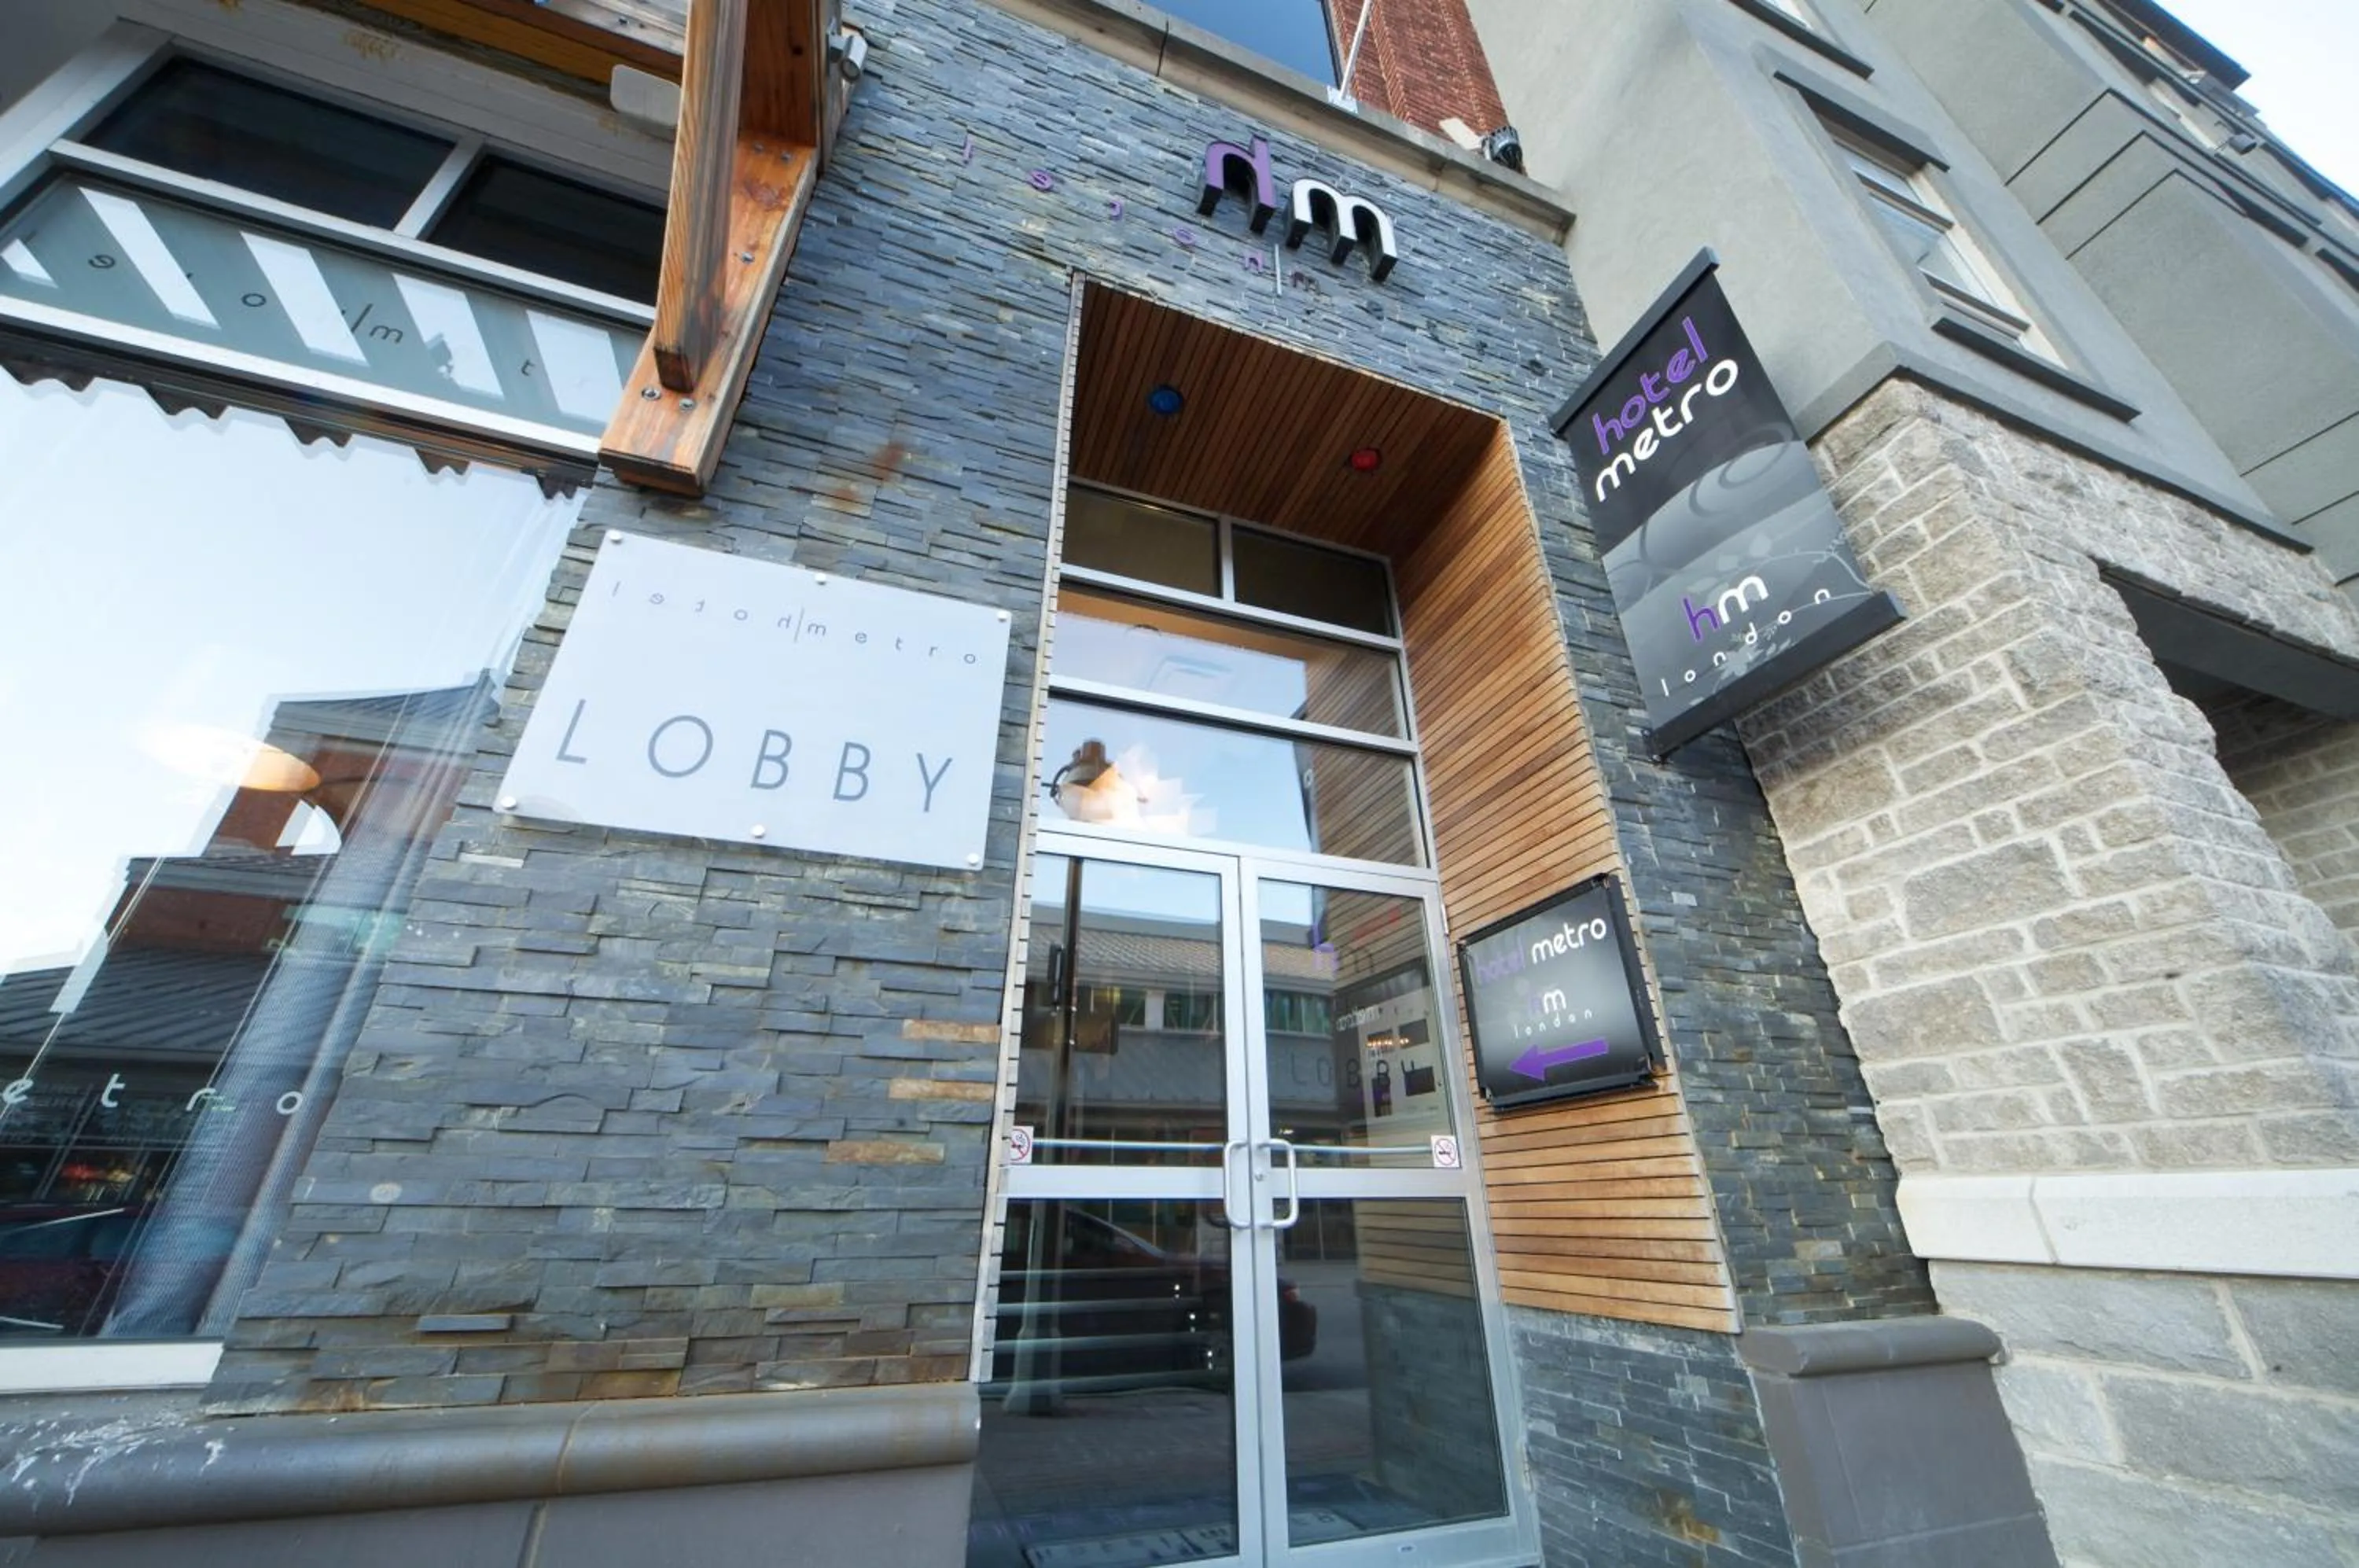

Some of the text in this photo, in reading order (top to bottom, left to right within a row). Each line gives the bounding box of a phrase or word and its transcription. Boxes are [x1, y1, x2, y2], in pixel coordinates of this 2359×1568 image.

[1593, 316, 1709, 454] hotel
[1595, 359, 1739, 502] metro
[1661, 588, 1831, 697] london
[1683, 575, 1768, 642] hm
[556, 698, 953, 813] LOBBY
[1474, 918, 1607, 985] hotel metro
[1514, 1010, 1593, 1037] london
